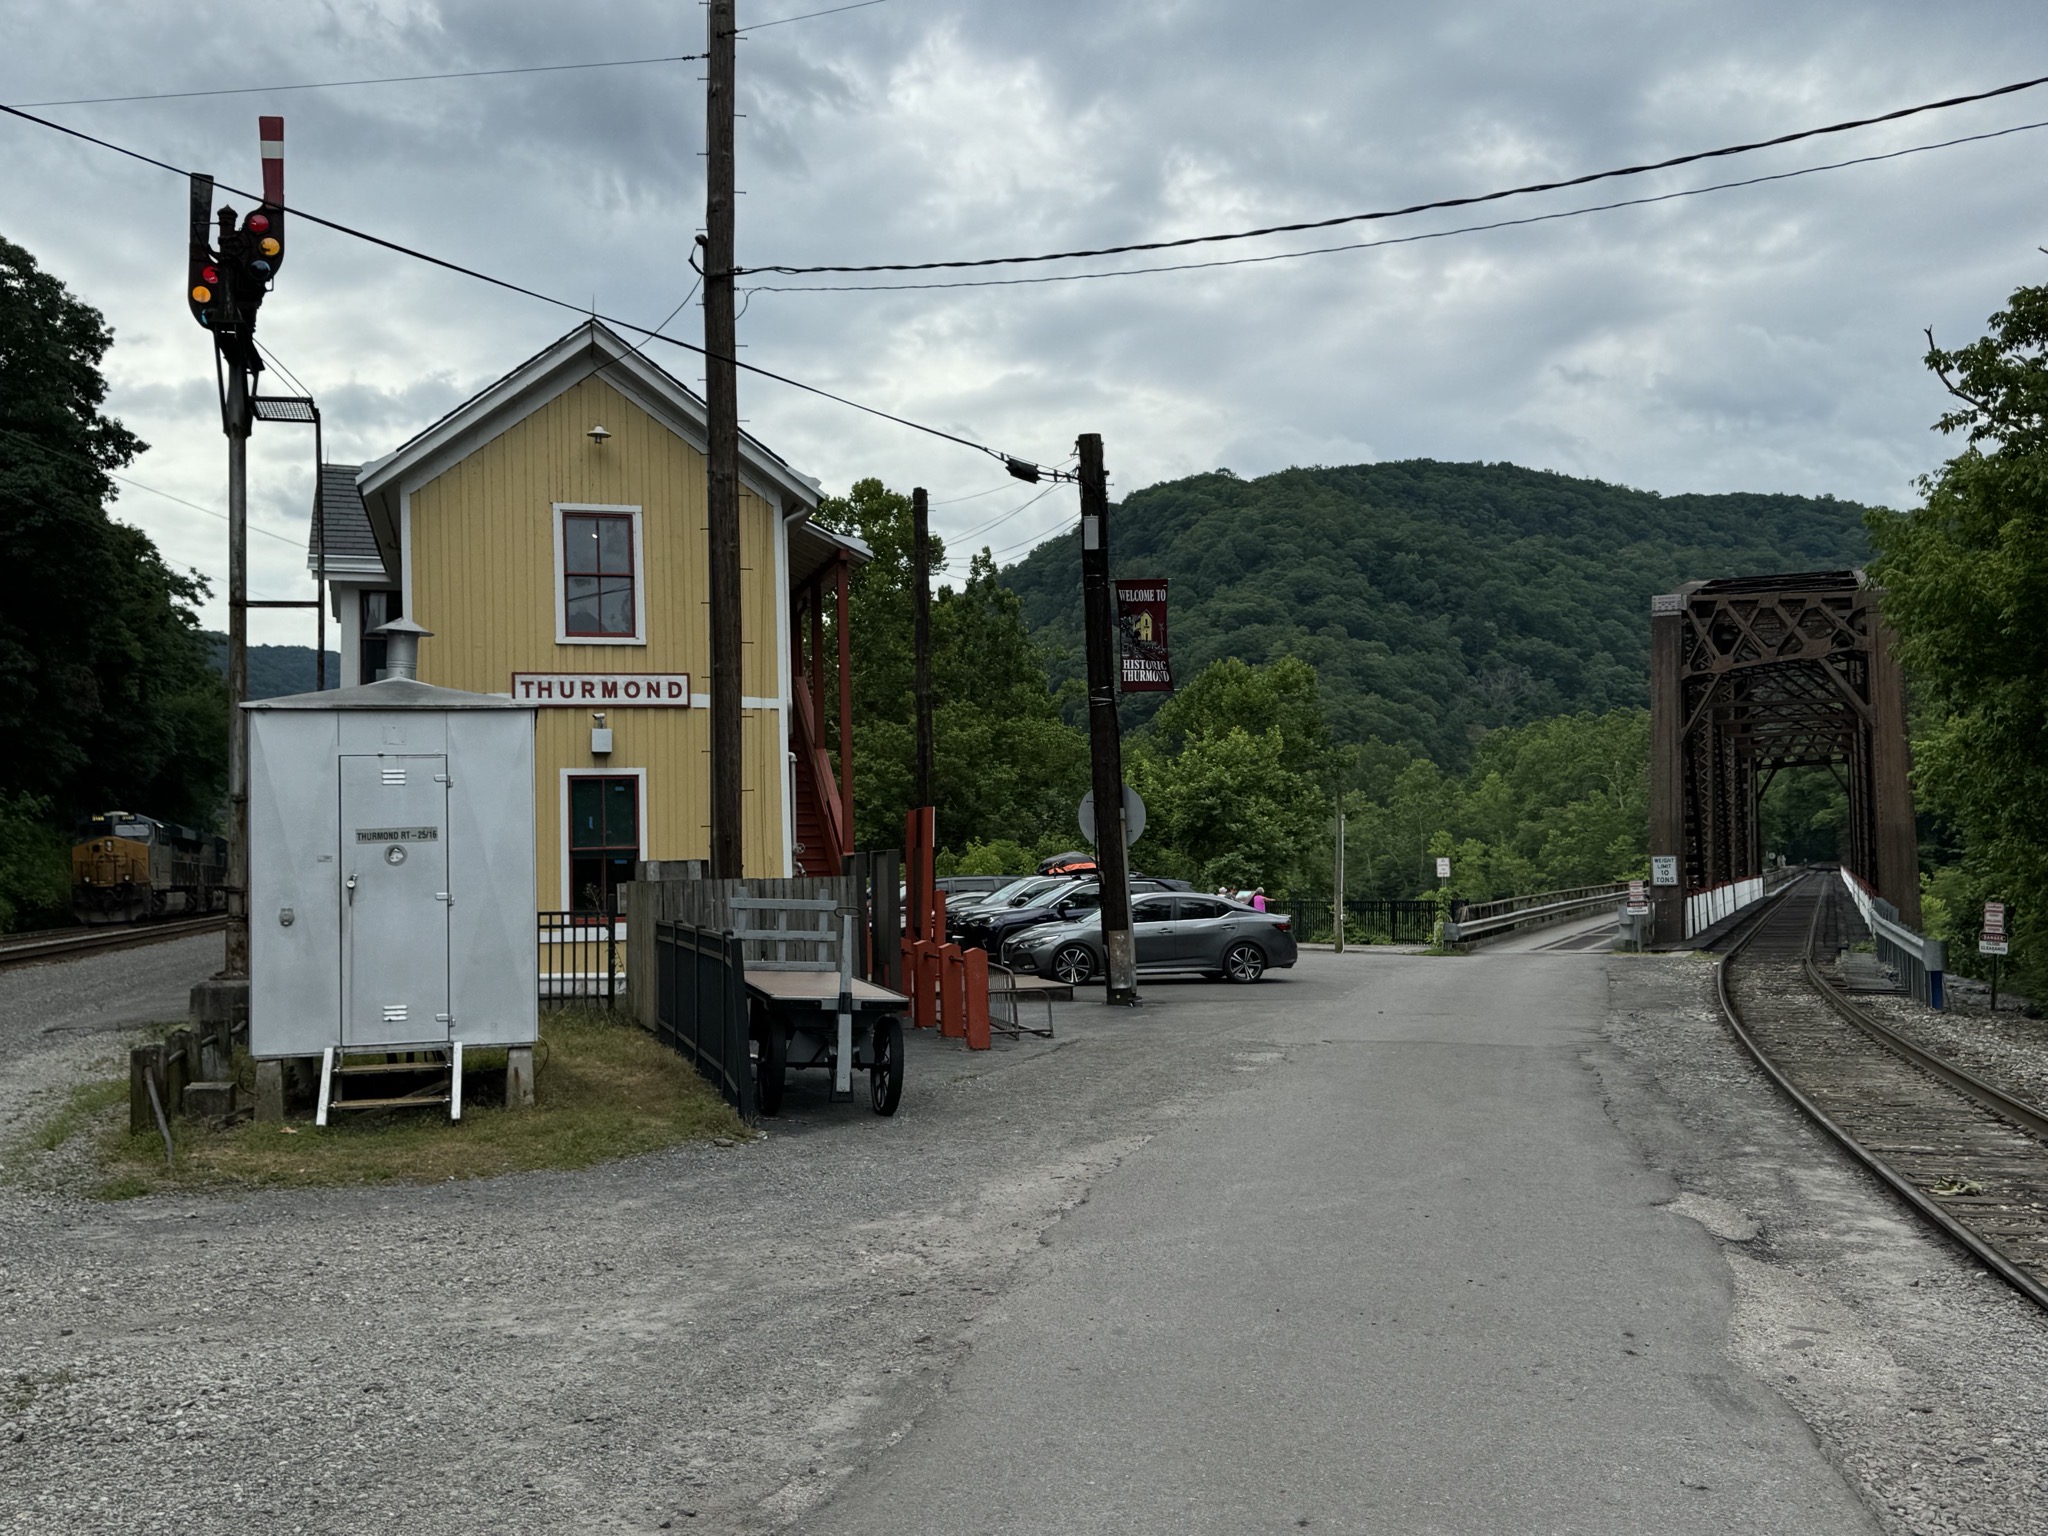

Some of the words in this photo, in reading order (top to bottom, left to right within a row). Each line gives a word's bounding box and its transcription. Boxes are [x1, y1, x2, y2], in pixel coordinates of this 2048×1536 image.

[1118, 589, 1155, 602] WELCOME
[1156, 589, 1166, 602] TO
[1122, 659, 1167, 670] HISTORIC
[1122, 670, 1170, 682] THURMOND
[520, 680, 683, 698] THURMOND
[356, 831, 399, 841] THURMOND
